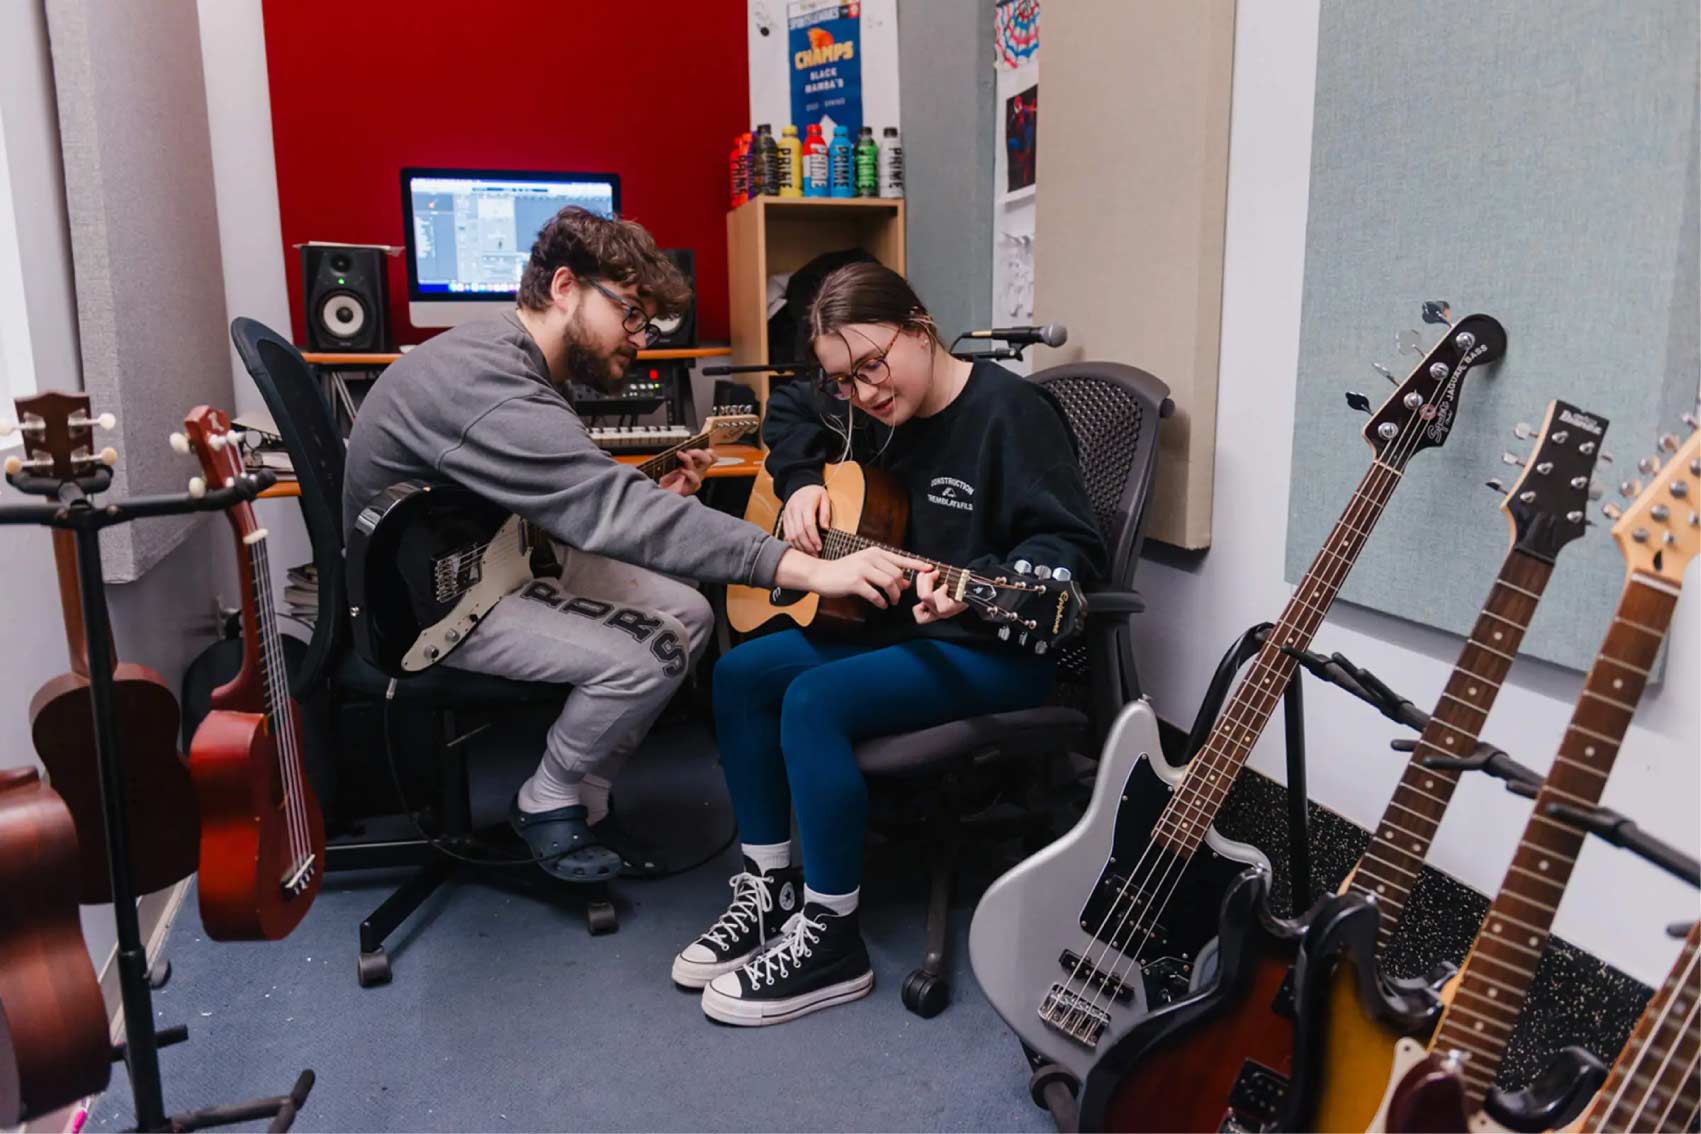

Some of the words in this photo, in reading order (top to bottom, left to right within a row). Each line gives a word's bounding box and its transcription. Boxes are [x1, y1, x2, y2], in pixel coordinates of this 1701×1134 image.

[795, 40, 854, 70] CHAMPS
[776, 148, 792, 187] PRIME
[809, 144, 828, 188] PRIME
[833, 146, 849, 187] PRIME
[888, 147, 903, 188] PRIME
[1465, 344, 1488, 364] BASS
